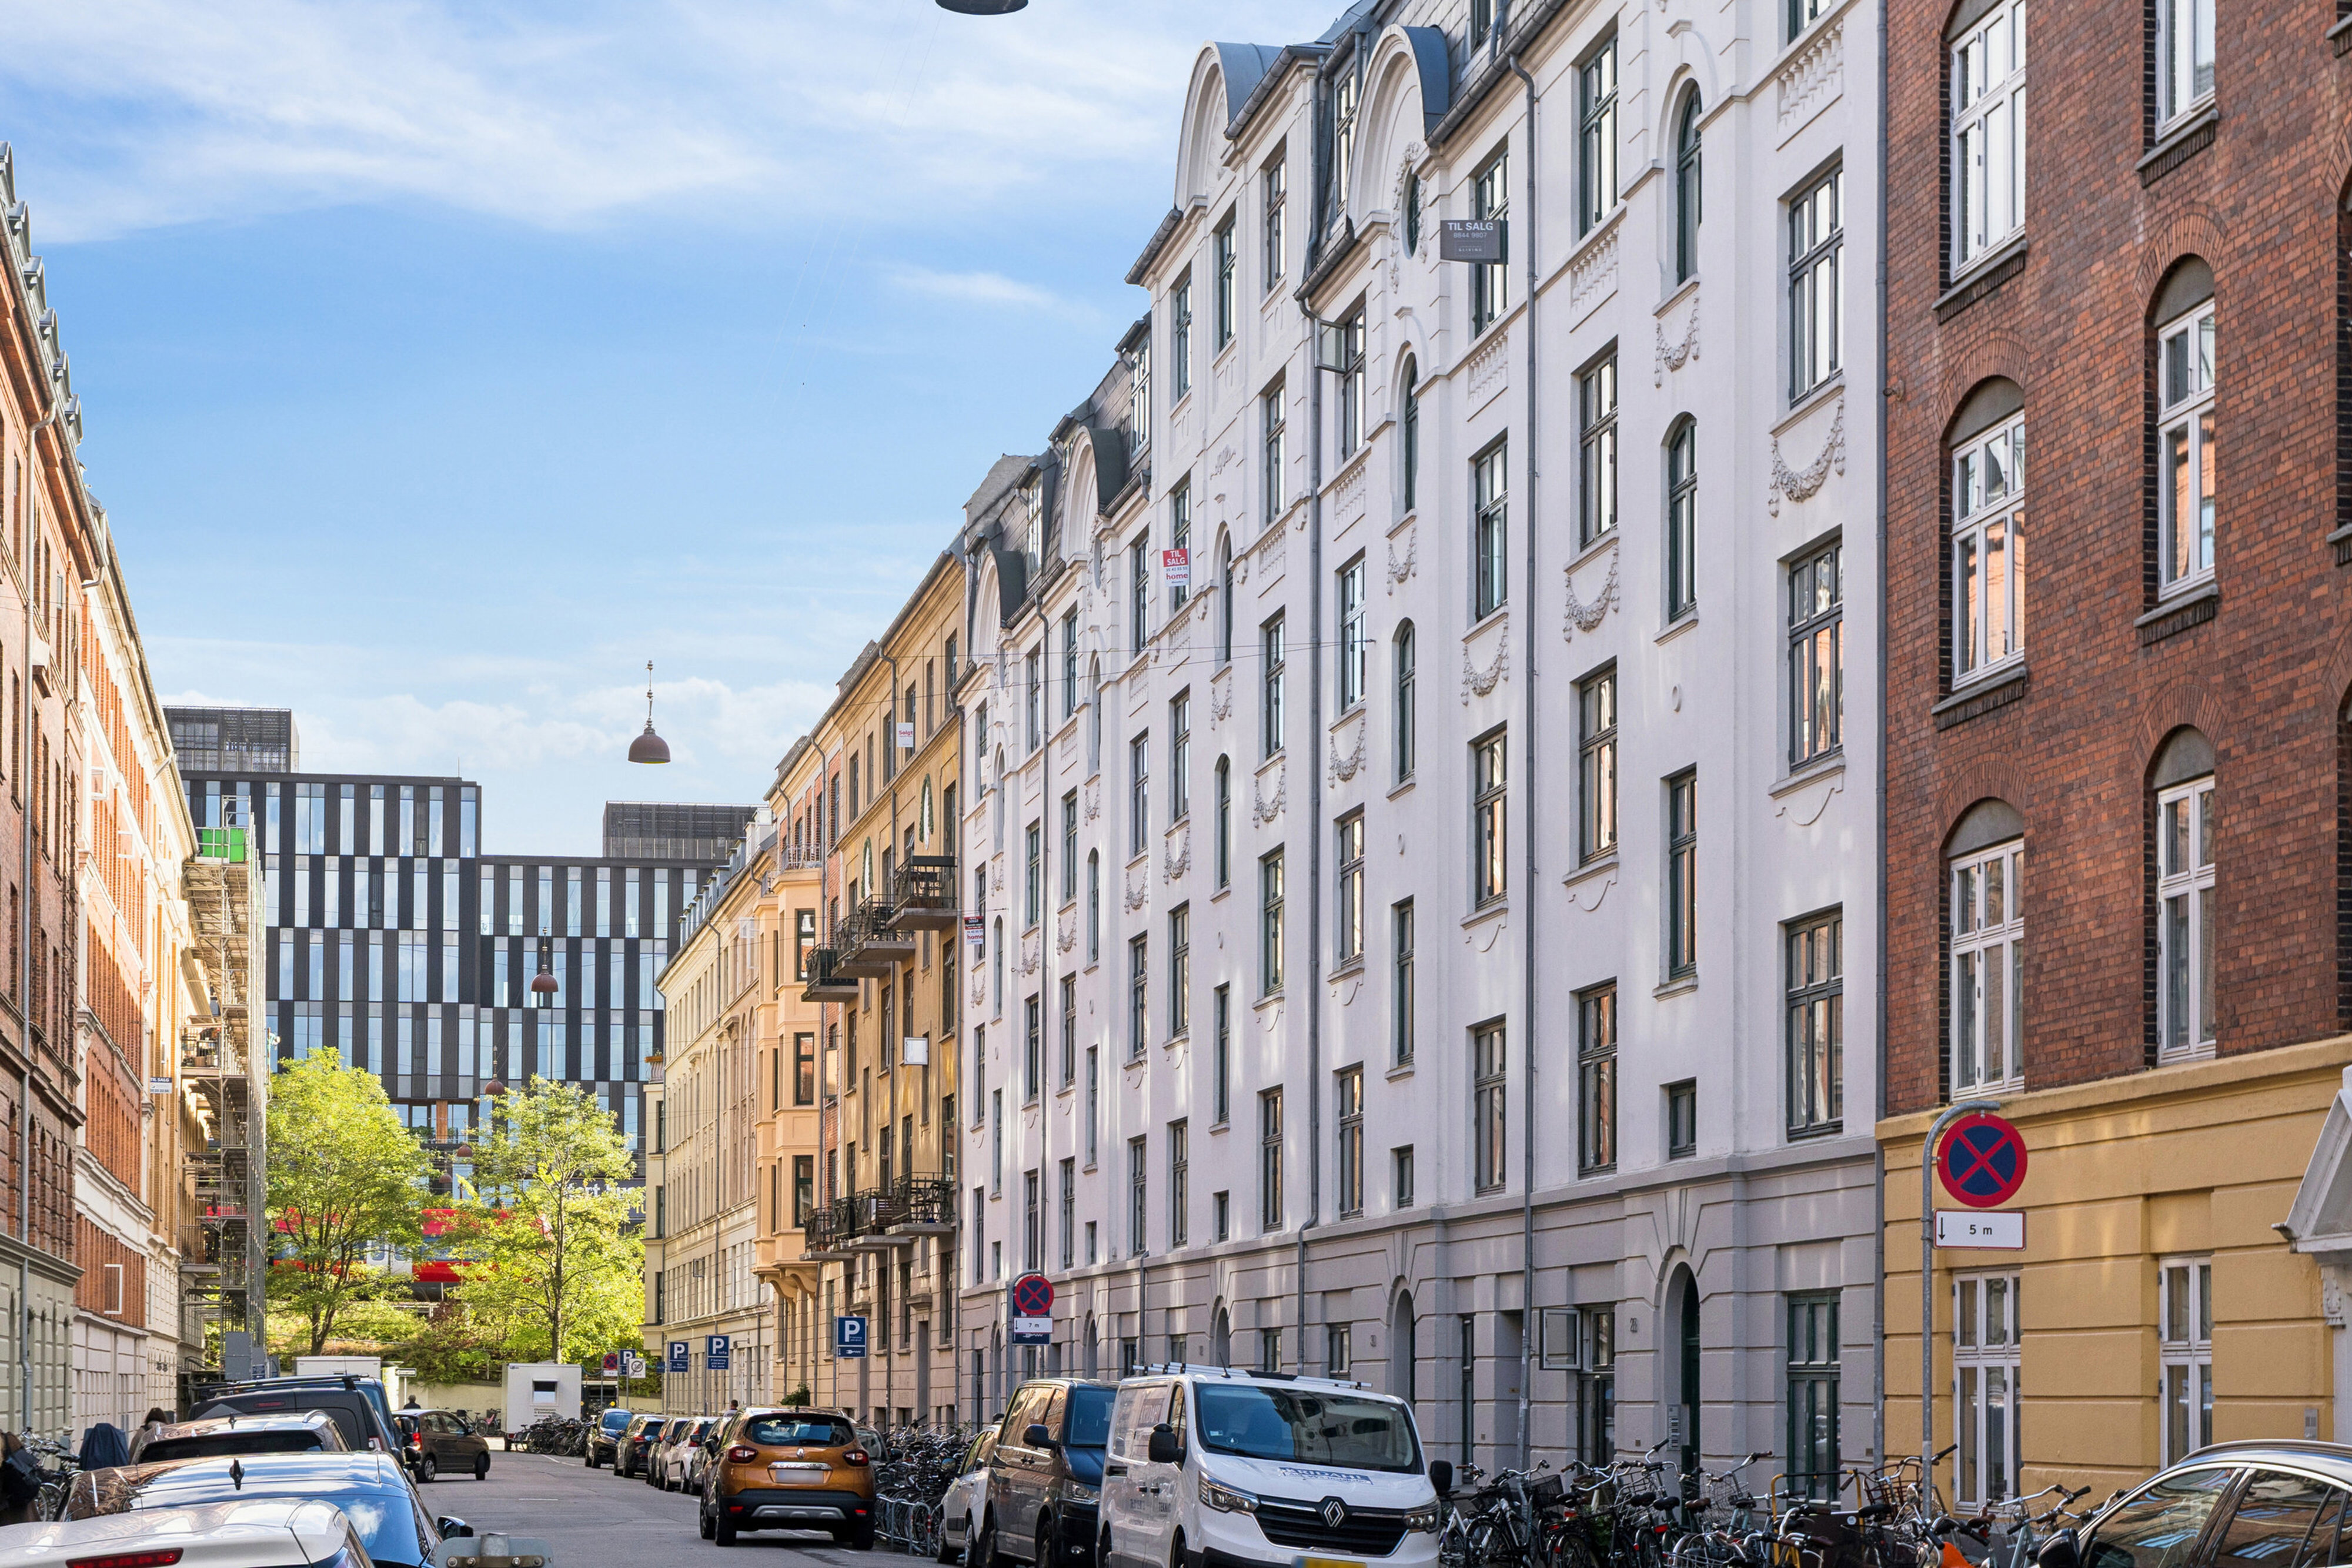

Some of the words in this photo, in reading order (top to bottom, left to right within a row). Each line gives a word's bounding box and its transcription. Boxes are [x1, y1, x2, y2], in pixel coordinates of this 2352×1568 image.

[1448, 222, 1463, 231] TIL
[1465, 222, 1494, 231] SALG
[1167, 557, 1185, 566] SALG
[1969, 1225, 1976, 1235] 5
[1983, 1226, 1993, 1235] m
[844, 1320, 860, 1342] P
[674, 1343, 685, 1359] P
[712, 1338, 724, 1355] P
[623, 1350, 633, 1364] P
